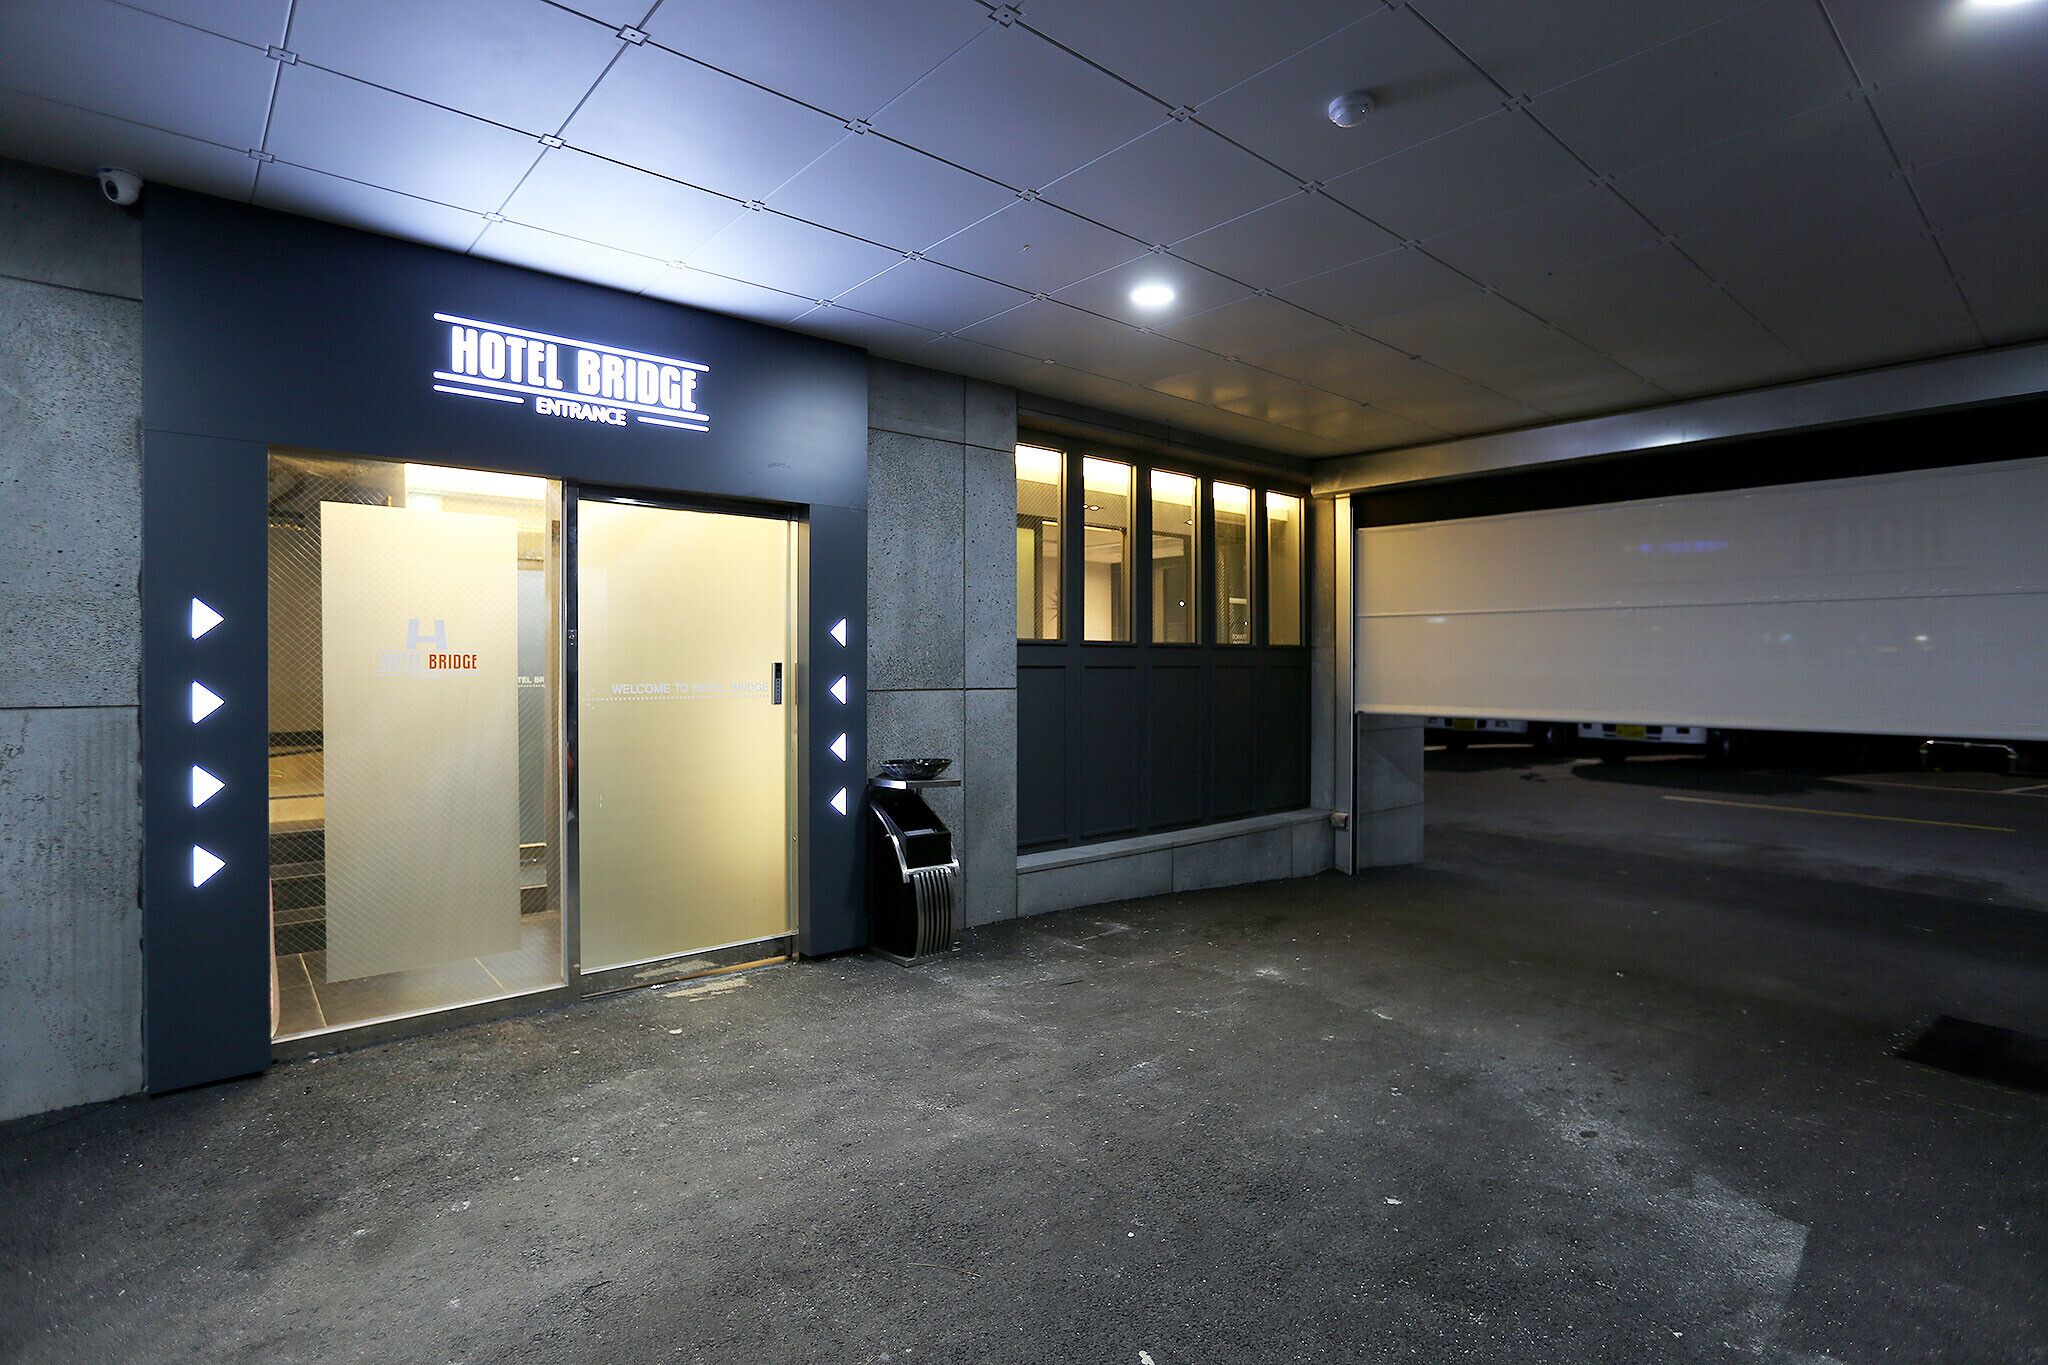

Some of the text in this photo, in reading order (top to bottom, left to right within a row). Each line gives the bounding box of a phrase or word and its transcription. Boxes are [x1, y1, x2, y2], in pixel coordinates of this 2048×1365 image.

[451, 325, 697, 412] HOTEL BRIDGE
[535, 396, 628, 427] ENTRANCE
[429, 653, 477, 669] BRIDGE
[612, 683, 671, 695] WELCOME
[674, 682, 689, 693] TO
